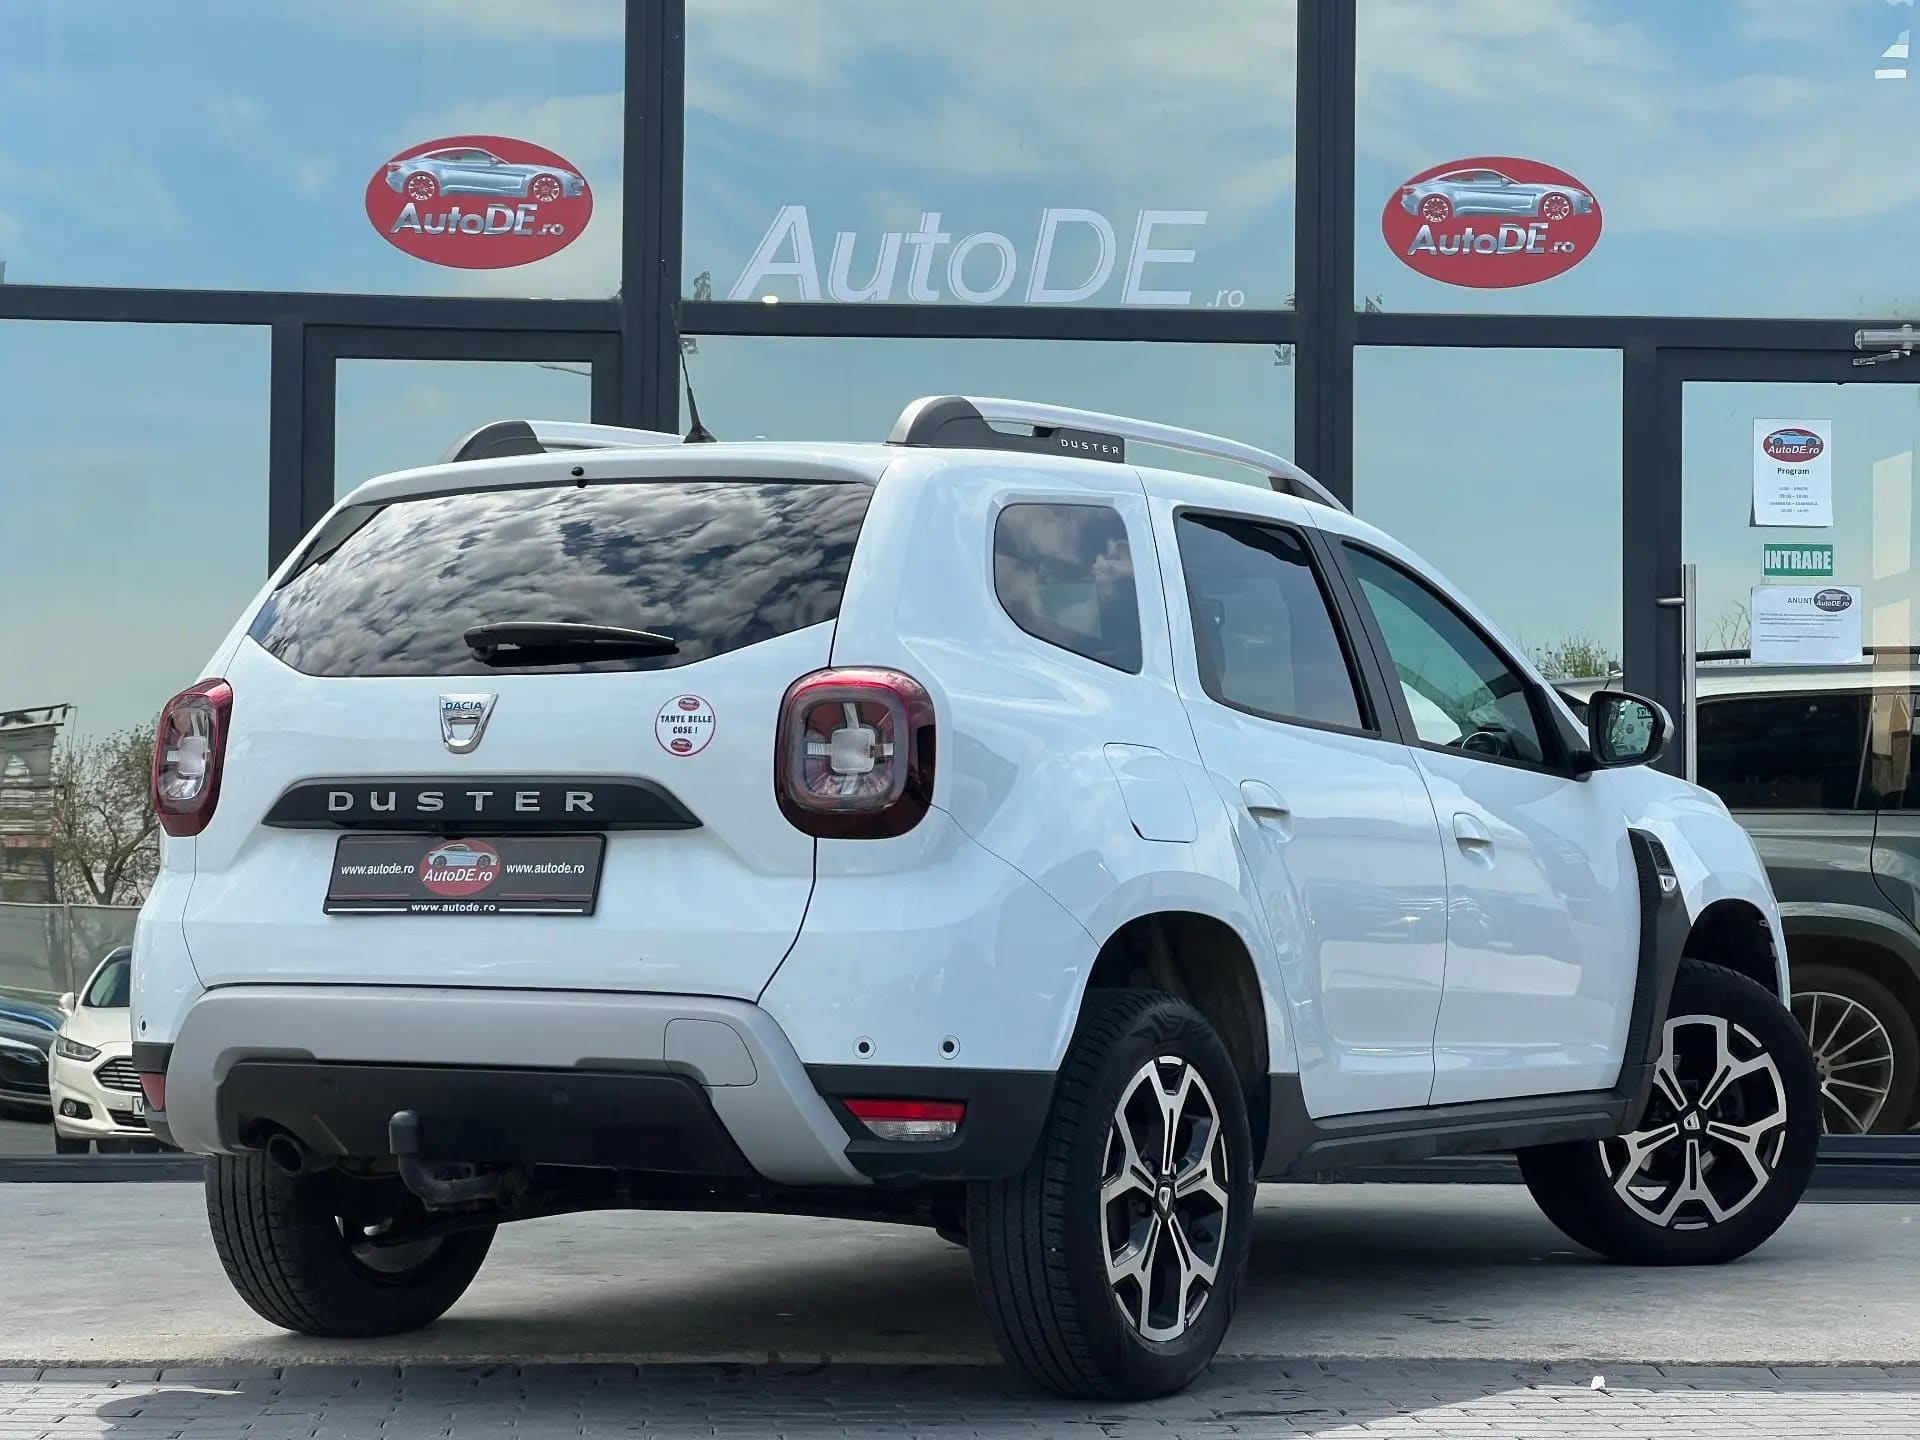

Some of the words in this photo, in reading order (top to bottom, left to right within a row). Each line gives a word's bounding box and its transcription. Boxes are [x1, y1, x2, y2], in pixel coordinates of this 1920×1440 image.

[728, 204, 1208, 305] AutoDE
[1060, 439, 1119, 454] DUSTER
[1777, 467, 1810, 475] Program
[1764, 550, 1832, 569] INTRARE
[445, 701, 483, 710] DACIA
[672, 726, 692, 734] COSE
[328, 791, 594, 812] DUSTER
[341, 863, 415, 875] www.autode.ro
[506, 862, 585, 874] www.autode.ro
[422, 868, 493, 882] AutoDE.ro
[411, 903, 496, 912] www.autode.ro
